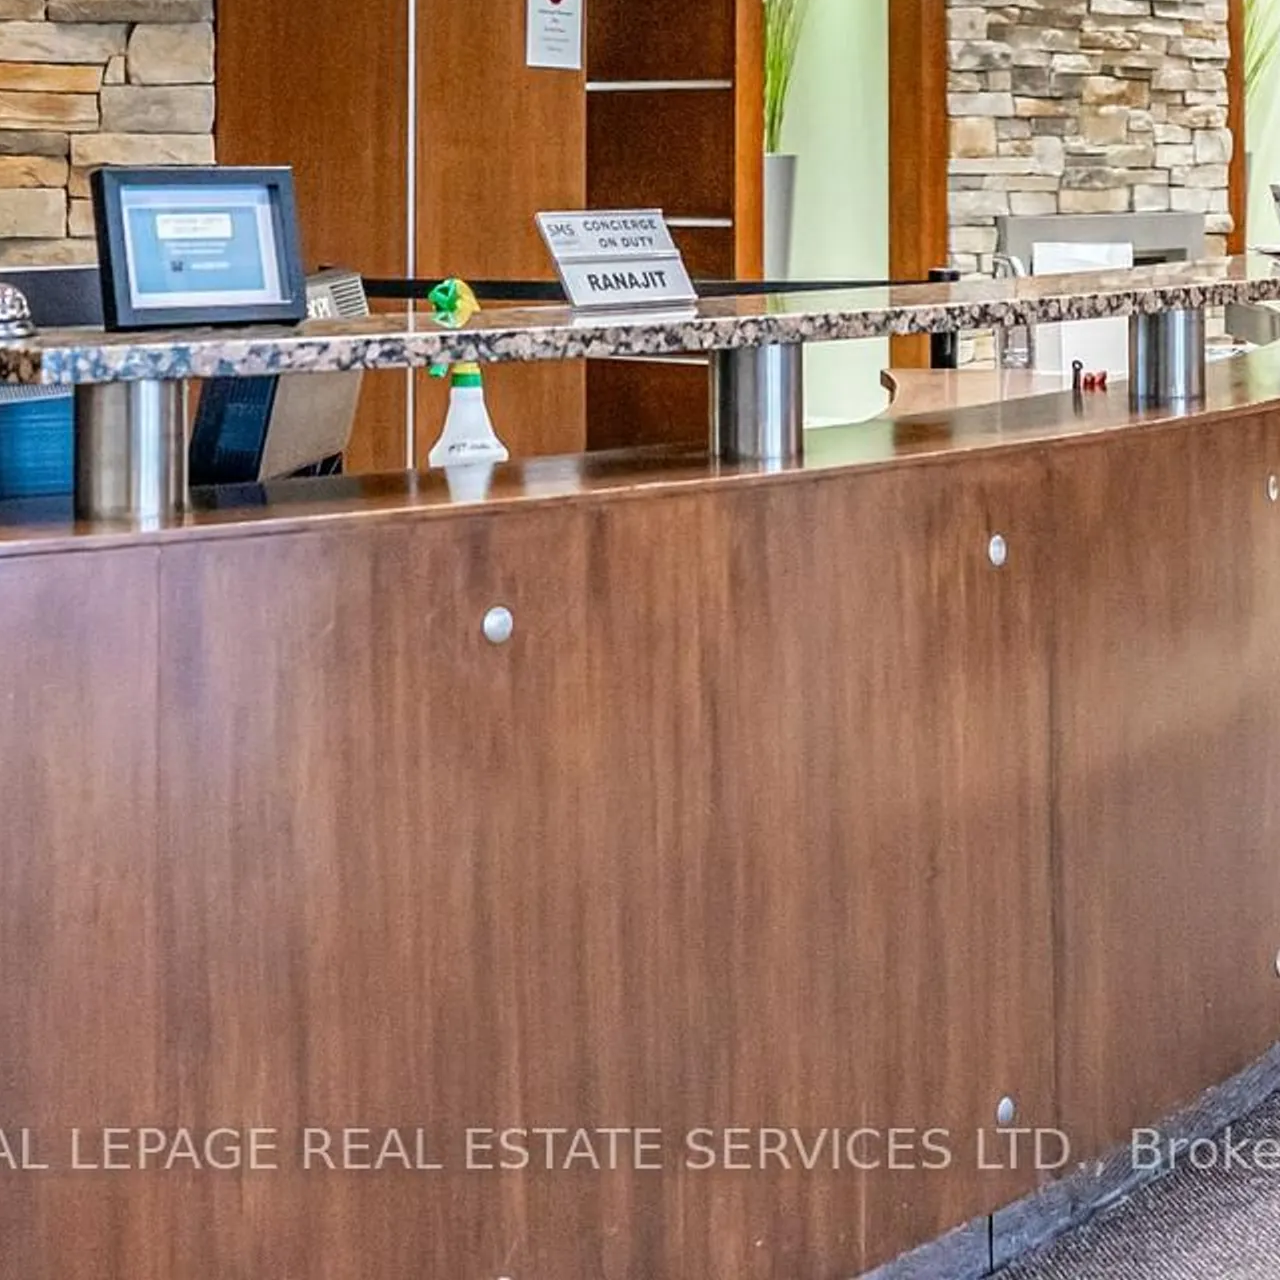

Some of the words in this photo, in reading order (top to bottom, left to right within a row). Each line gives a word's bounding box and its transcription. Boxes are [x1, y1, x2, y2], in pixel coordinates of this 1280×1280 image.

[582, 219, 657, 232] CONCIERGE
[598, 237, 617, 248] ON
[621, 236, 654, 248] DUTY
[587, 271, 668, 292] RANAJIT
